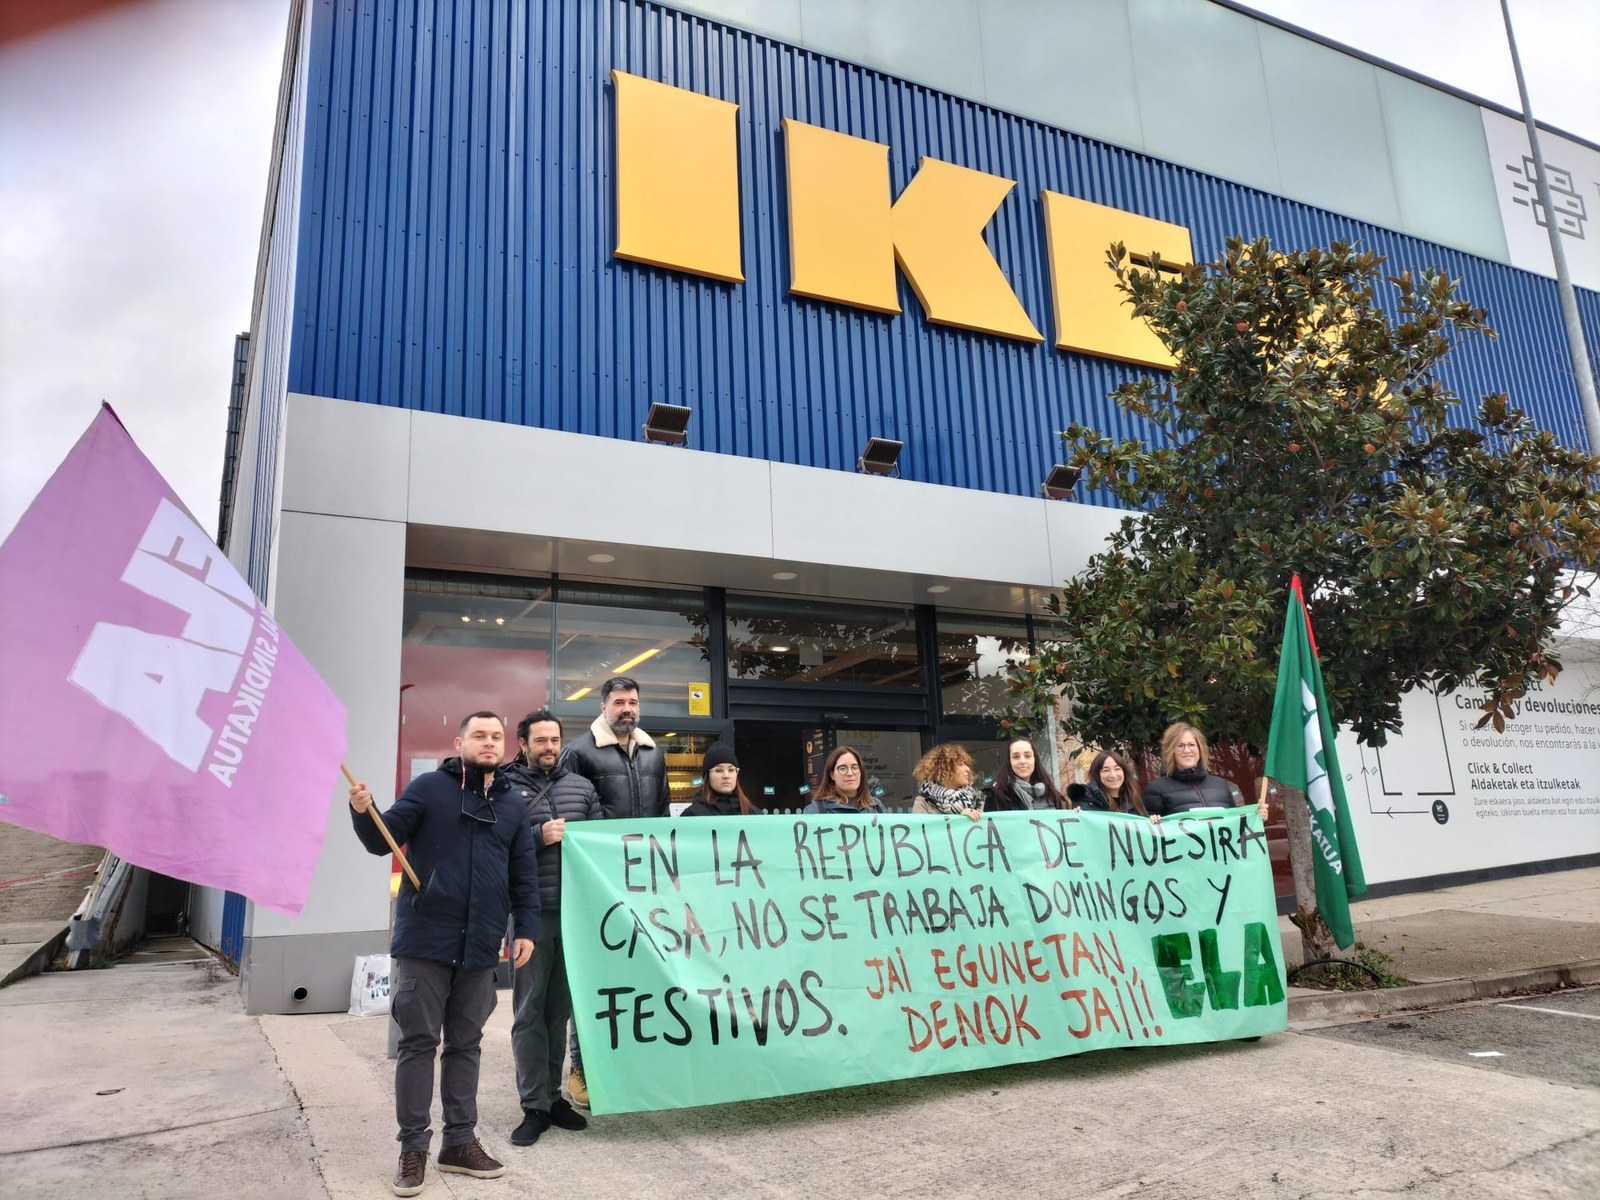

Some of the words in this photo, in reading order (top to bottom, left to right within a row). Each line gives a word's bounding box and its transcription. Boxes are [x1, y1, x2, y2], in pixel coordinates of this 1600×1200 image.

[611, 69, 1395, 410] IKE
[1513, 699, 1521, 715] y
[1459, 720, 1468, 731] Si
[1504, 722, 1533, 735] ecoger
[1534, 722, 1544, 732] tu
[1545, 723, 1574, 735] pedido,
[1575, 724, 1595, 735] hacer
[1470, 736, 1517, 749] devolución,
[1519, 738, 1534, 748] nos
[1583, 741, 1588, 749] a
[1589, 739, 1597, 749] la
[1467, 762, 1491, 774] Click
[1492, 762, 1500, 774] &
[1501, 762, 1534, 774] Collect
[1471, 778, 1518, 790] Aldaketak
[1520, 779, 1535, 790] eta
[1536, 778, 1581, 790] itzulketak
[621, 828, 681, 895] EN
[712, 828, 767, 889] LA
[793, 815, 1012, 882] REPÚBLICA
[1029, 817, 1084, 869] DE
[1108, 814, 1266, 871] NUESTRA
[732, 898, 788, 951] NO
[800, 893, 848, 941] SE
[853, 884, 1010, 939] TRABAJA
[1023, 872, 1187, 925] DOMINGOS
[1207, 874, 1232, 926] Y
[1151, 922, 1285, 1020] ELA
[901, 994, 1041, 1052] DENOK
